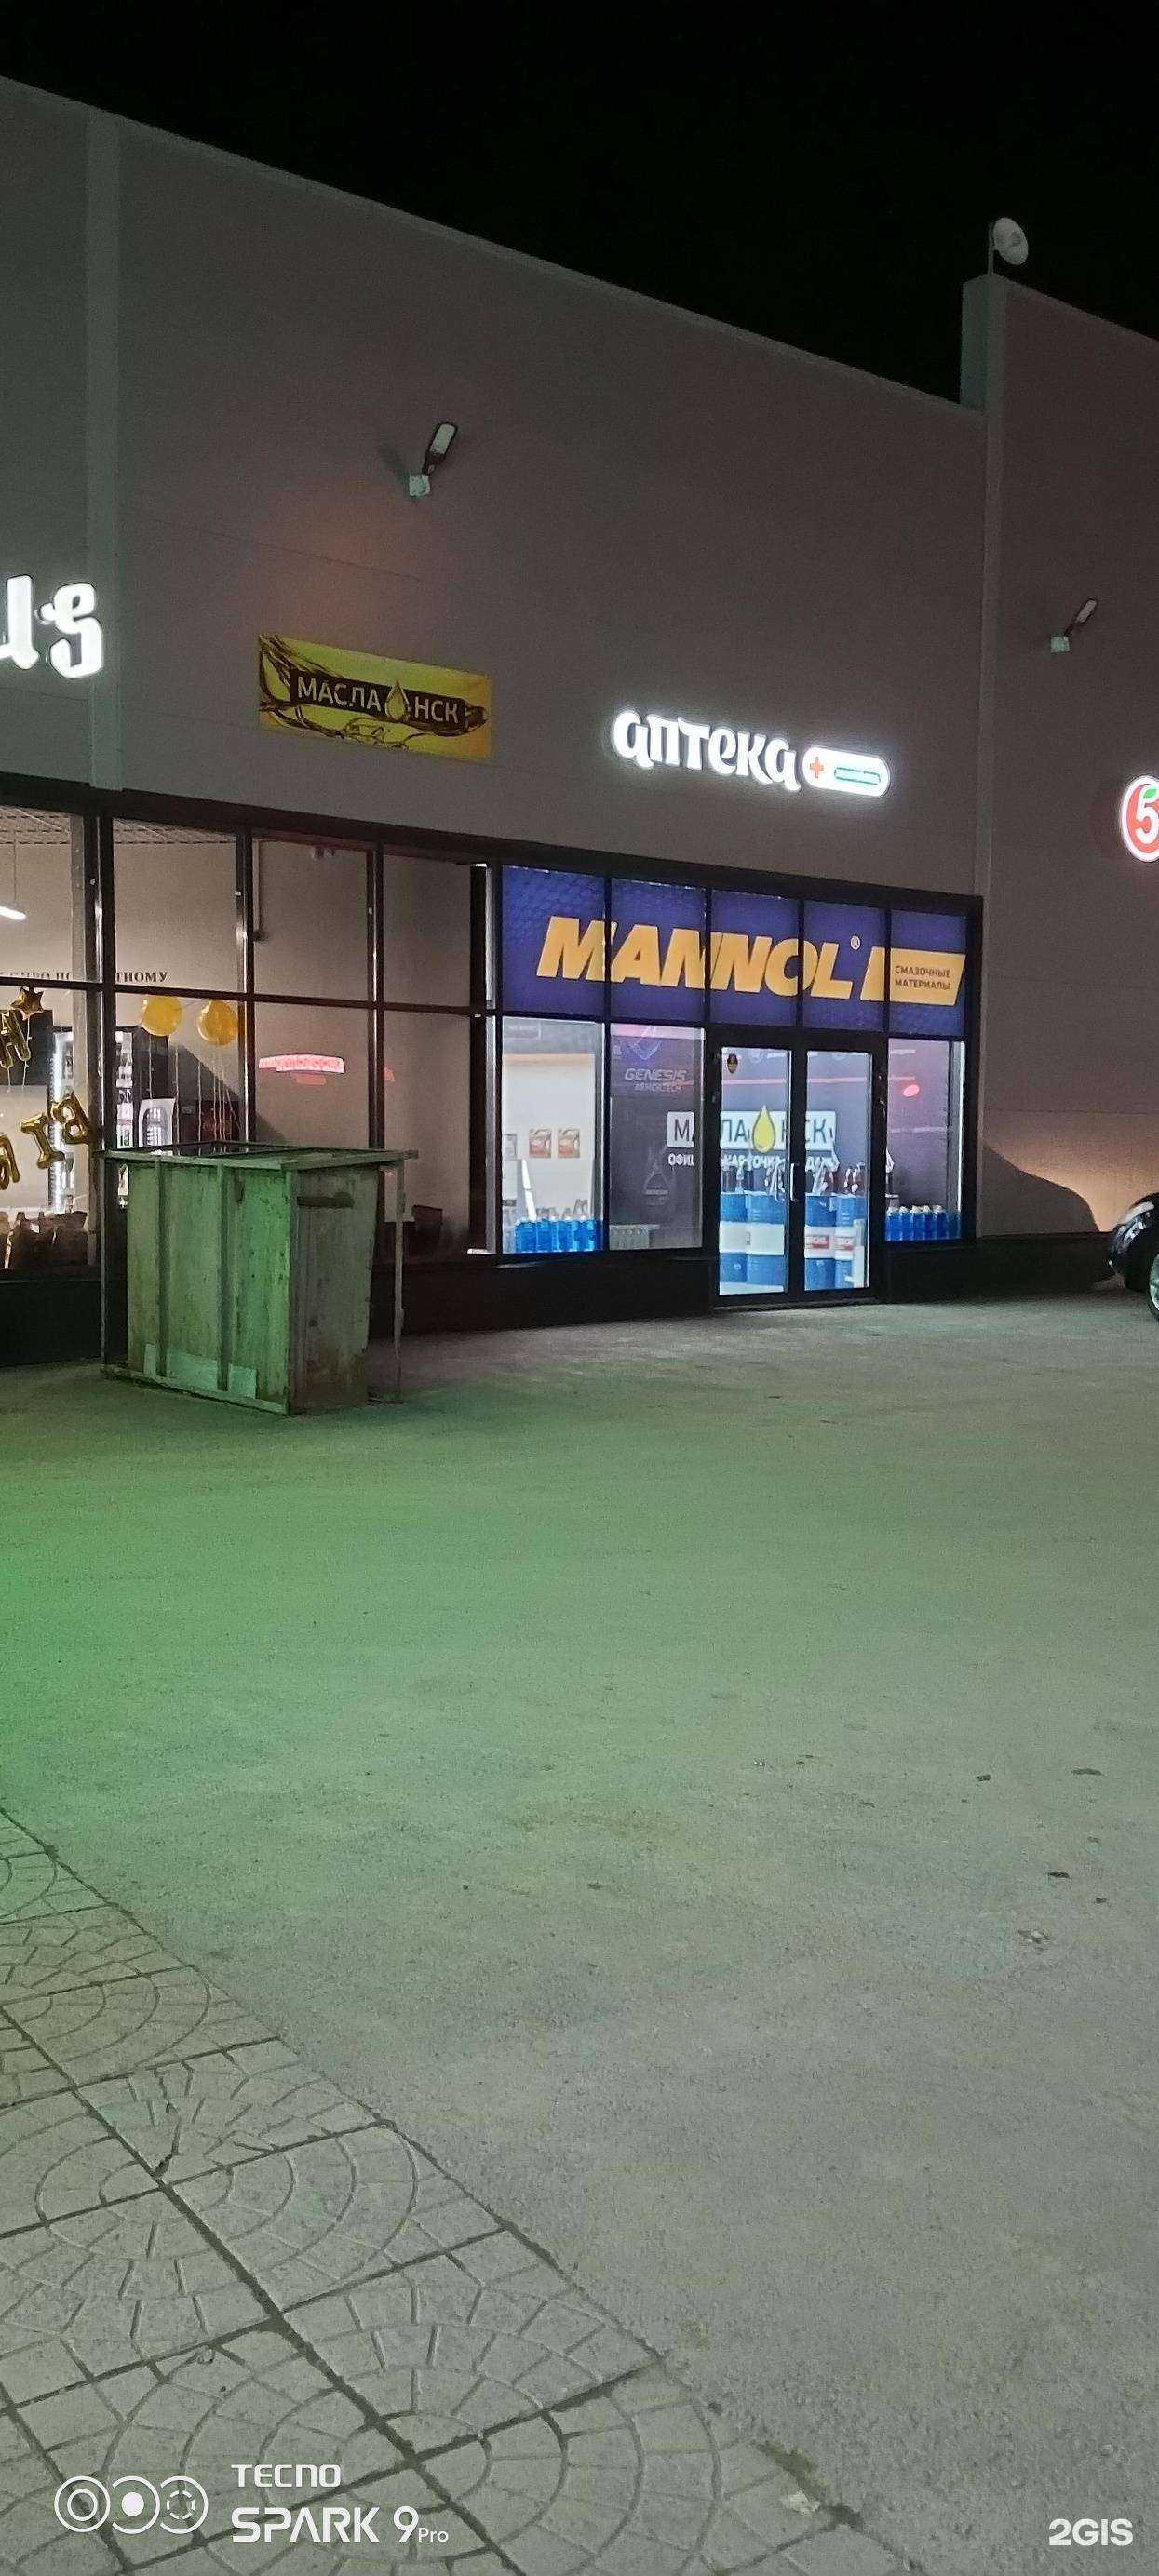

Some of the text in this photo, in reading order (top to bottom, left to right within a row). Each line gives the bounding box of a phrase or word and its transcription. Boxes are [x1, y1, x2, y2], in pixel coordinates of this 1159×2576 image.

[297, 676, 459, 724] МАСЛА НСК
[536, 915, 853, 1000] MANNOL
[895, 965, 950, 978] СМАЗОЧНЫЕ
[895, 978, 950, 991] МАТЕРИАЛЫ
[625, 1067, 688, 1081] GENESIS
